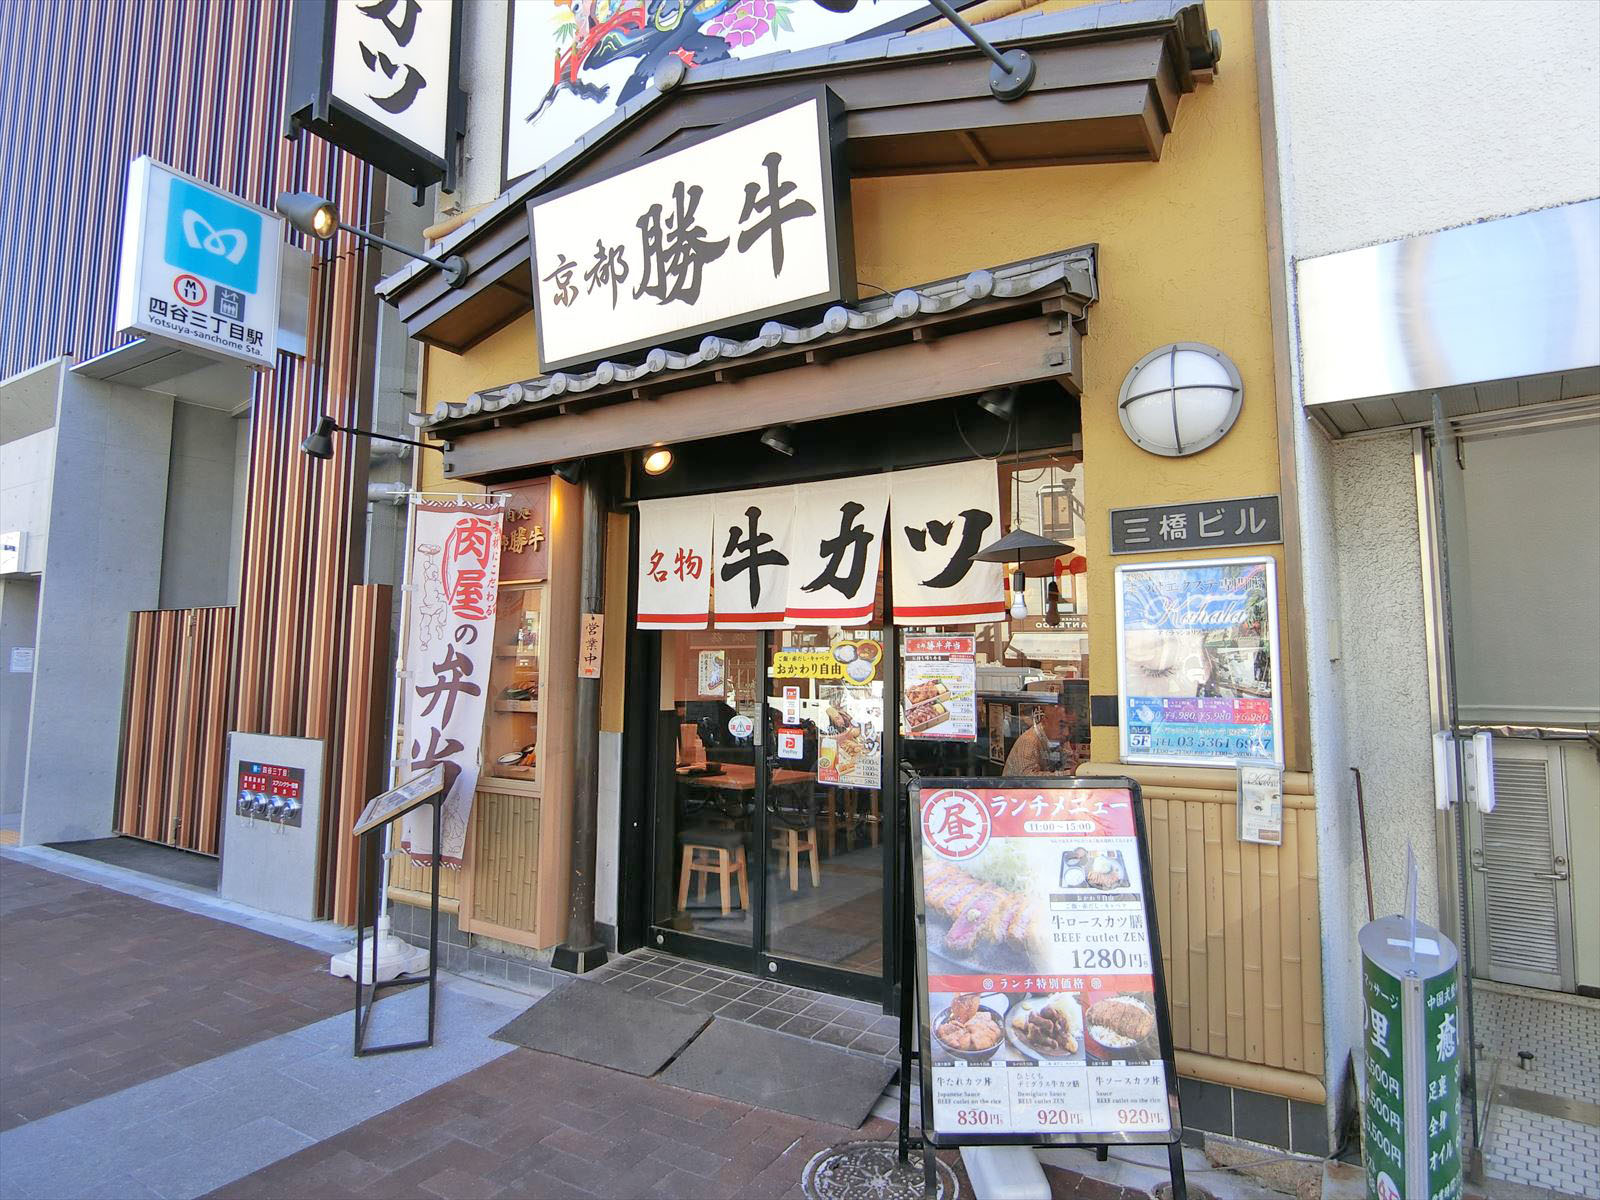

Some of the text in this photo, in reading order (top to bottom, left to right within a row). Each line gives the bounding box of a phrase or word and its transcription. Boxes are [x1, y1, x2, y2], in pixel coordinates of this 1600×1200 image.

[184, 288, 197, 300] 11
[186, 280, 196, 290] M
[149, 297, 263, 347] 四谷三丁目駅
[149, 315, 263, 356] Yotsuya-sanchome Sta.
[1124, 507, 1266, 544] 三橋ビル
[646, 501, 993, 609] 名物 牛カツ
[585, 622, 600, 665] 営業中
[777, 663, 841, 675] おかわり自由
[1132, 736, 1150, 747] 5F
[990, 794, 1129, 817] ランチメニュー
[937, 802, 977, 843] 昼
[1052, 915, 1142, 928] 牛ロースカツ膳
[1053, 931, 1146, 943] BEEF cutlet ZEN
[1000, 978, 1085, 989] ランチ特別価格
